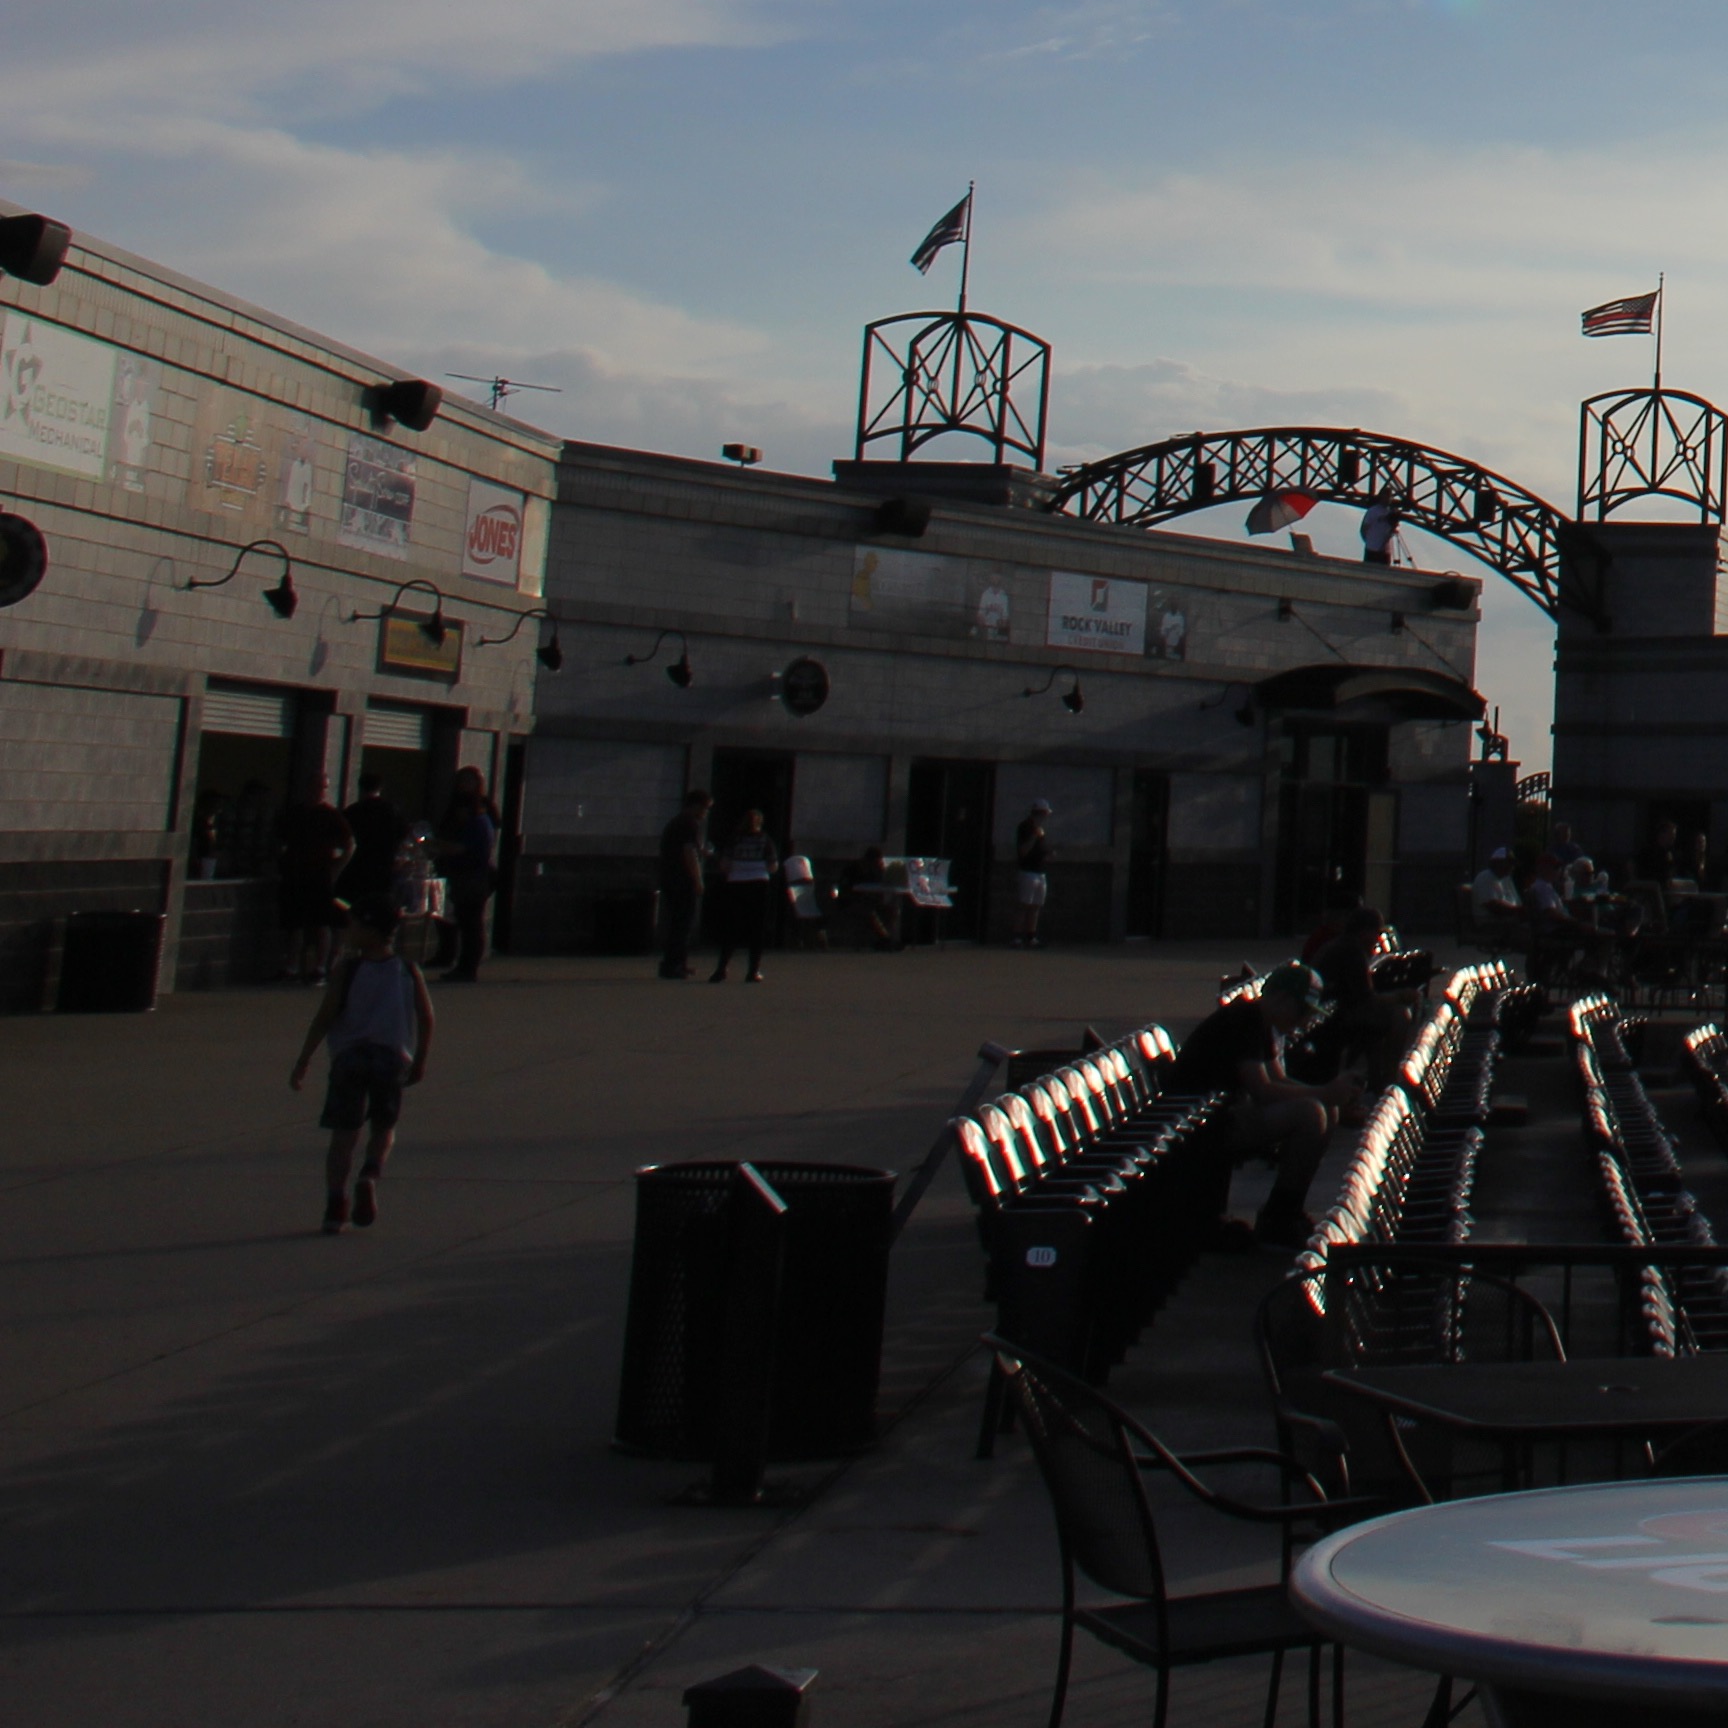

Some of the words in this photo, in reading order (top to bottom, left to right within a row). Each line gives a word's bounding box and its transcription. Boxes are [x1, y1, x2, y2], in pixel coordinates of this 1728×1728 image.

[33, 384, 106, 429] GEOSTAR
[28, 418, 103, 459] MECHANICAL
[469, 514, 518, 560] JONES
[1061, 615, 1091, 633] ROCK
[1094, 618, 1135, 637] VALLEY
[1034, 1249, 1052, 1264] 10
